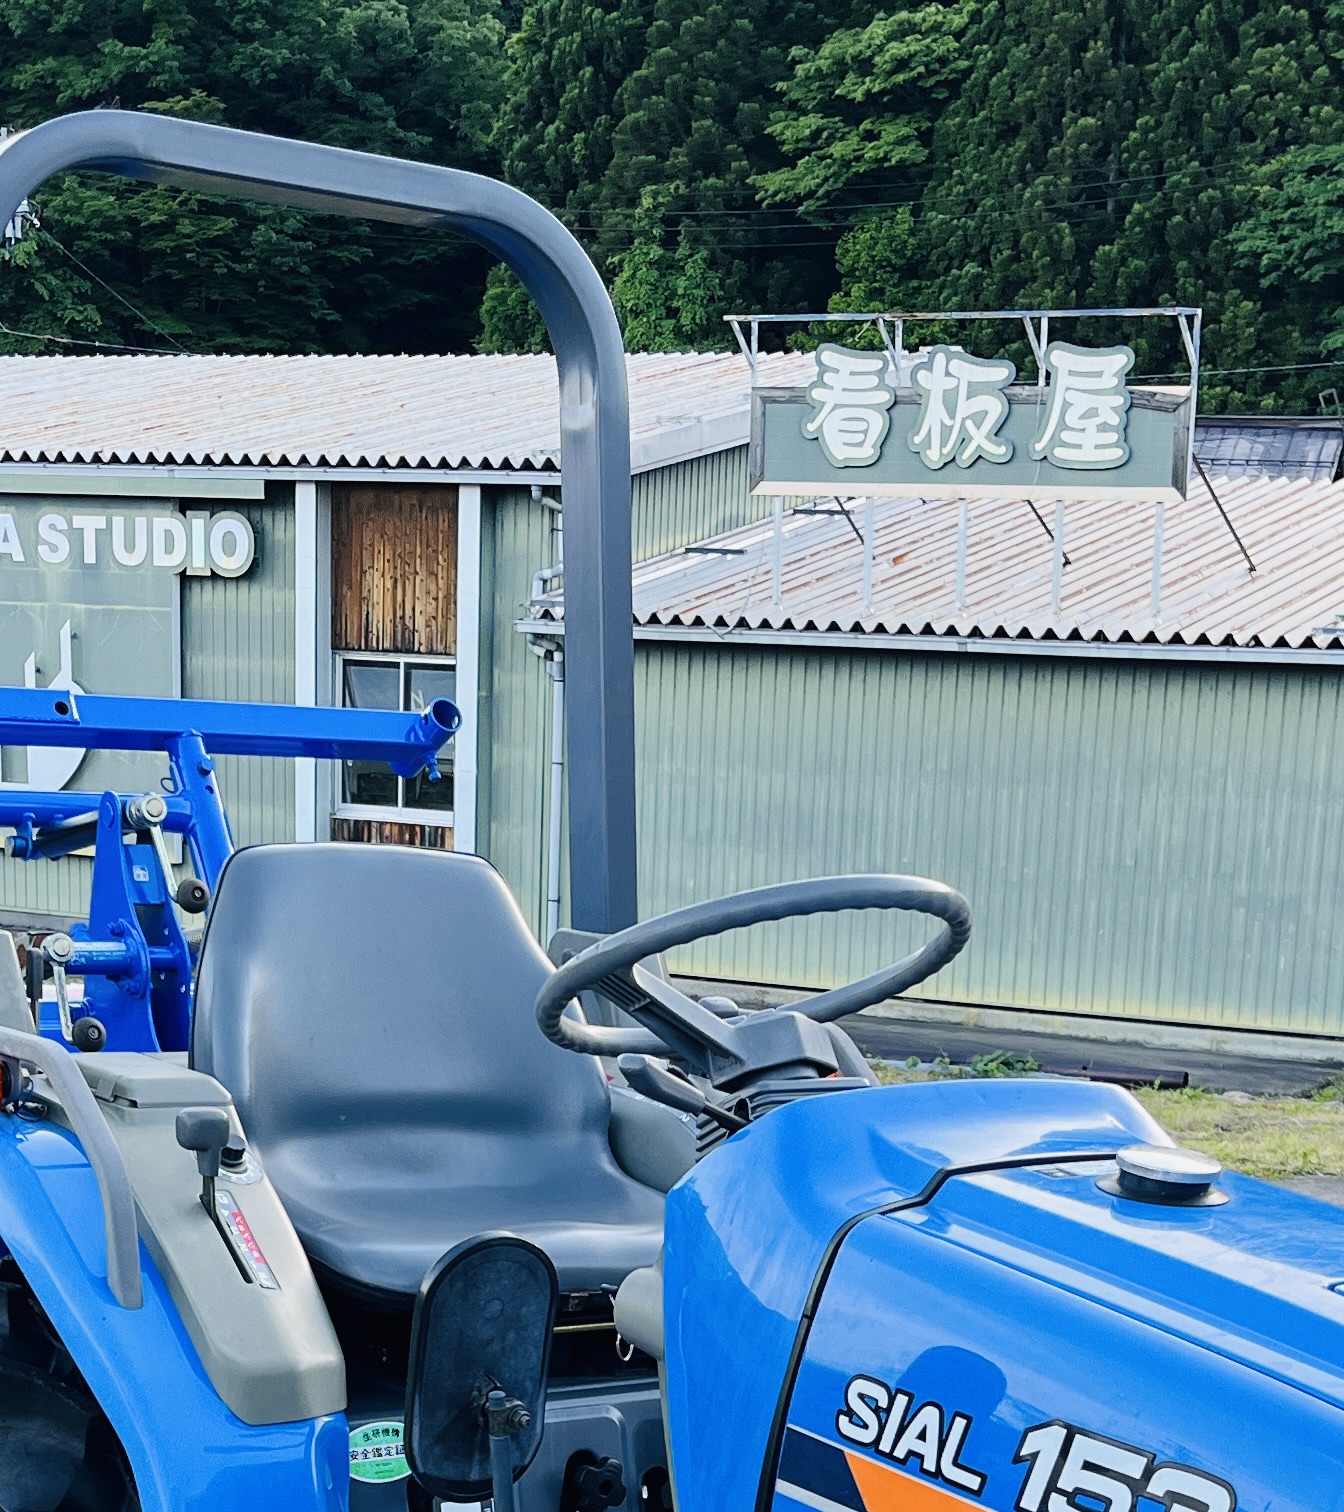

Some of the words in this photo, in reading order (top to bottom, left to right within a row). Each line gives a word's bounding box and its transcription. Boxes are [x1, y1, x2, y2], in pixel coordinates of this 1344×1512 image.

[804, 345, 1131, 465] 看板屋
[37, 513, 249, 570] STUDIO
[837, 1376, 986, 1495] SIAL
